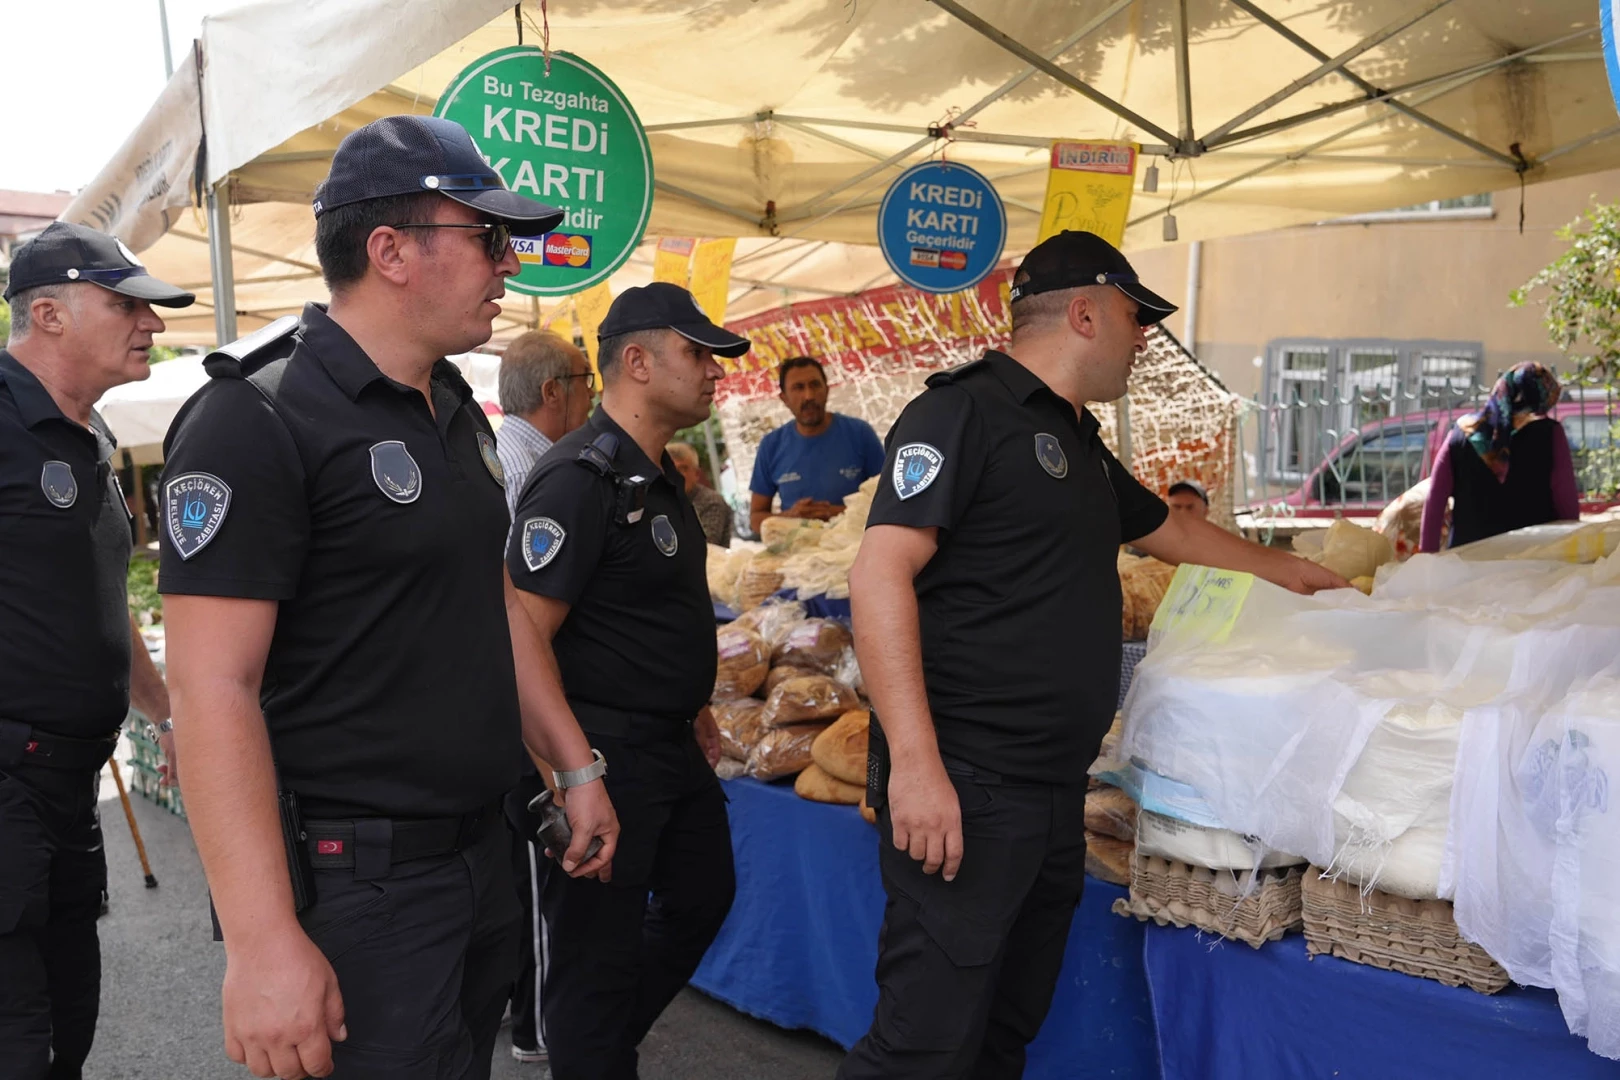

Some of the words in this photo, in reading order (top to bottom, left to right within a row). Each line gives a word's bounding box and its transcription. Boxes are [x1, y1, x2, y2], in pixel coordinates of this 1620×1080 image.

[483, 75, 513, 98] Bu
[520, 81, 609, 113] Tezgahta
[906, 208, 979, 236] KARTI
[545, 244, 590, 257] MasterCard
[906, 230, 976, 250] Geçerlidir
[173, 478, 223, 501] KEÇİÖREN
[170, 499, 187, 545] BELEDİYE
[195, 503, 223, 545] ZABITASI
